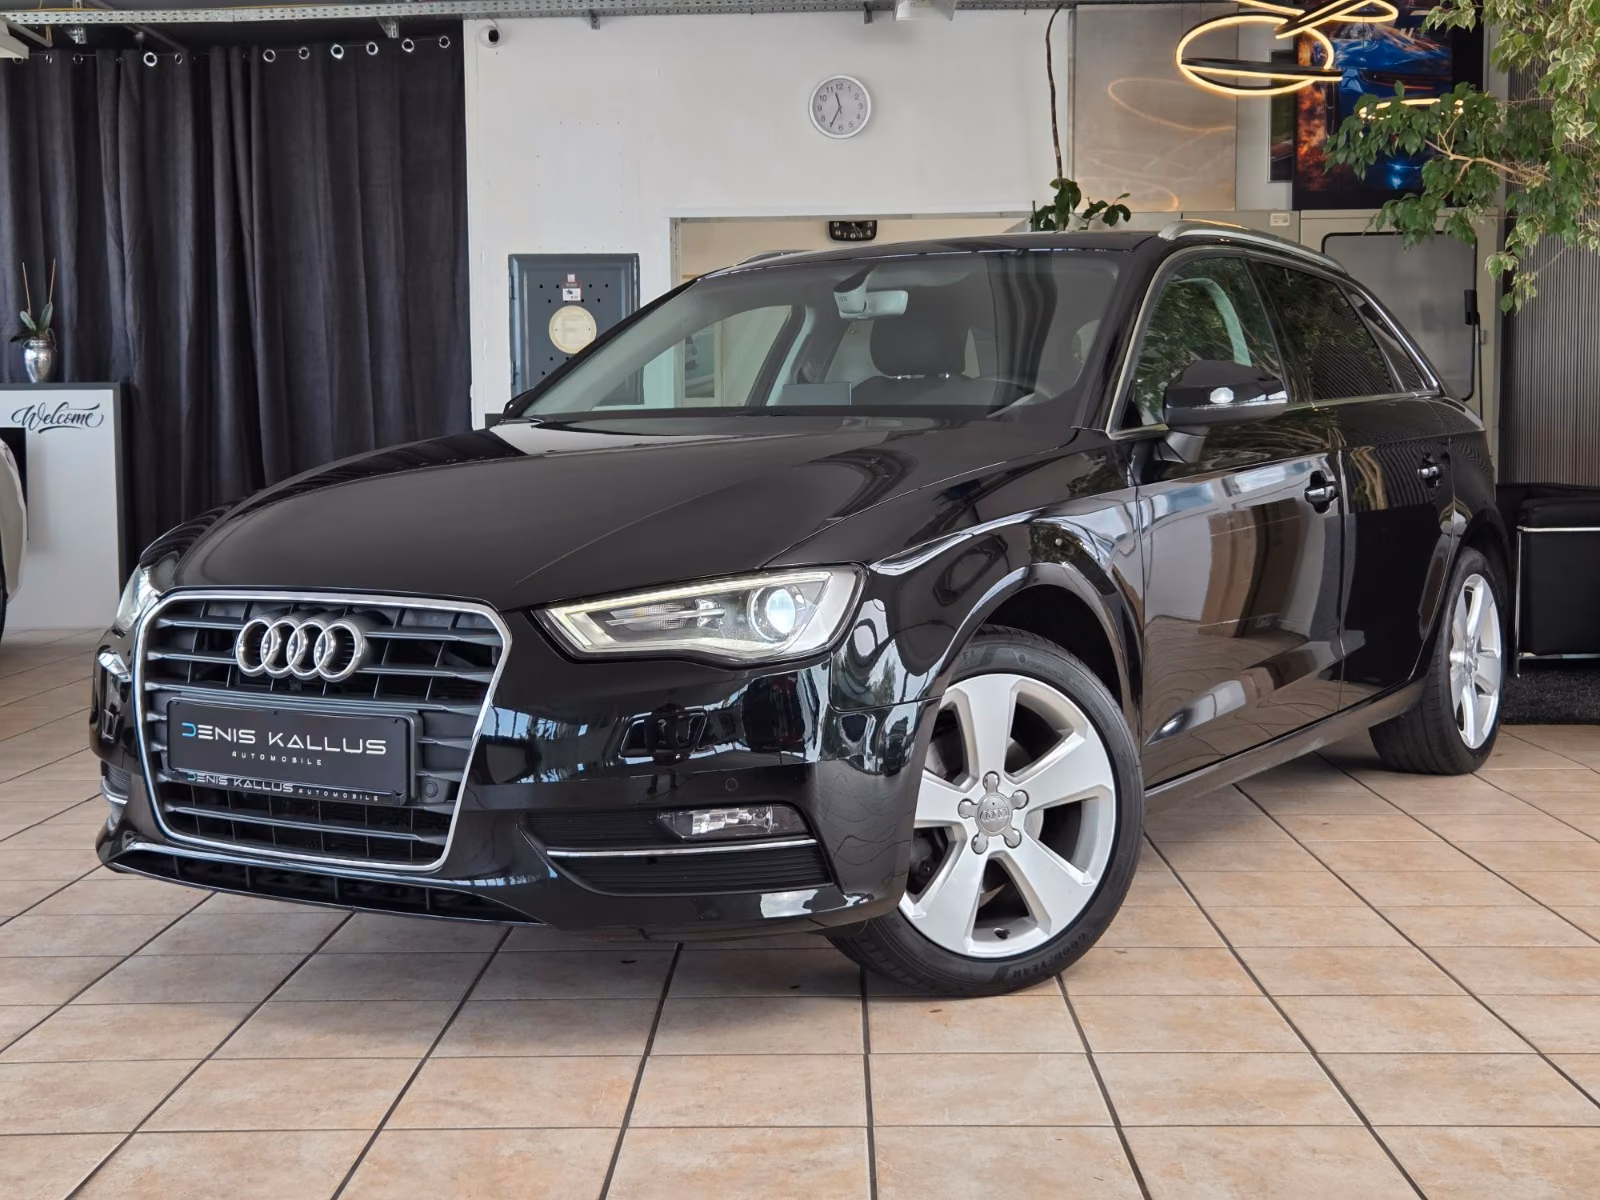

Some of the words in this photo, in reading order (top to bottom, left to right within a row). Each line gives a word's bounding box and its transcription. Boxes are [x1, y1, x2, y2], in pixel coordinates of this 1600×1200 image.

[819, 94, 827, 102] 10
[854, 93, 859, 101] 2
[817, 104, 822, 112] 9
[821, 114, 825, 122] 8
[11, 401, 104, 431] Welcome
[181, 722, 256, 745] DENIS
[268, 731, 387, 755] KALLUS
[231, 751, 323, 766] AUTOMOBILE
[187, 771, 228, 786] DENIS
[233, 777, 294, 793] KALLUS
[298, 788, 379, 802] AUTOMOBILE
